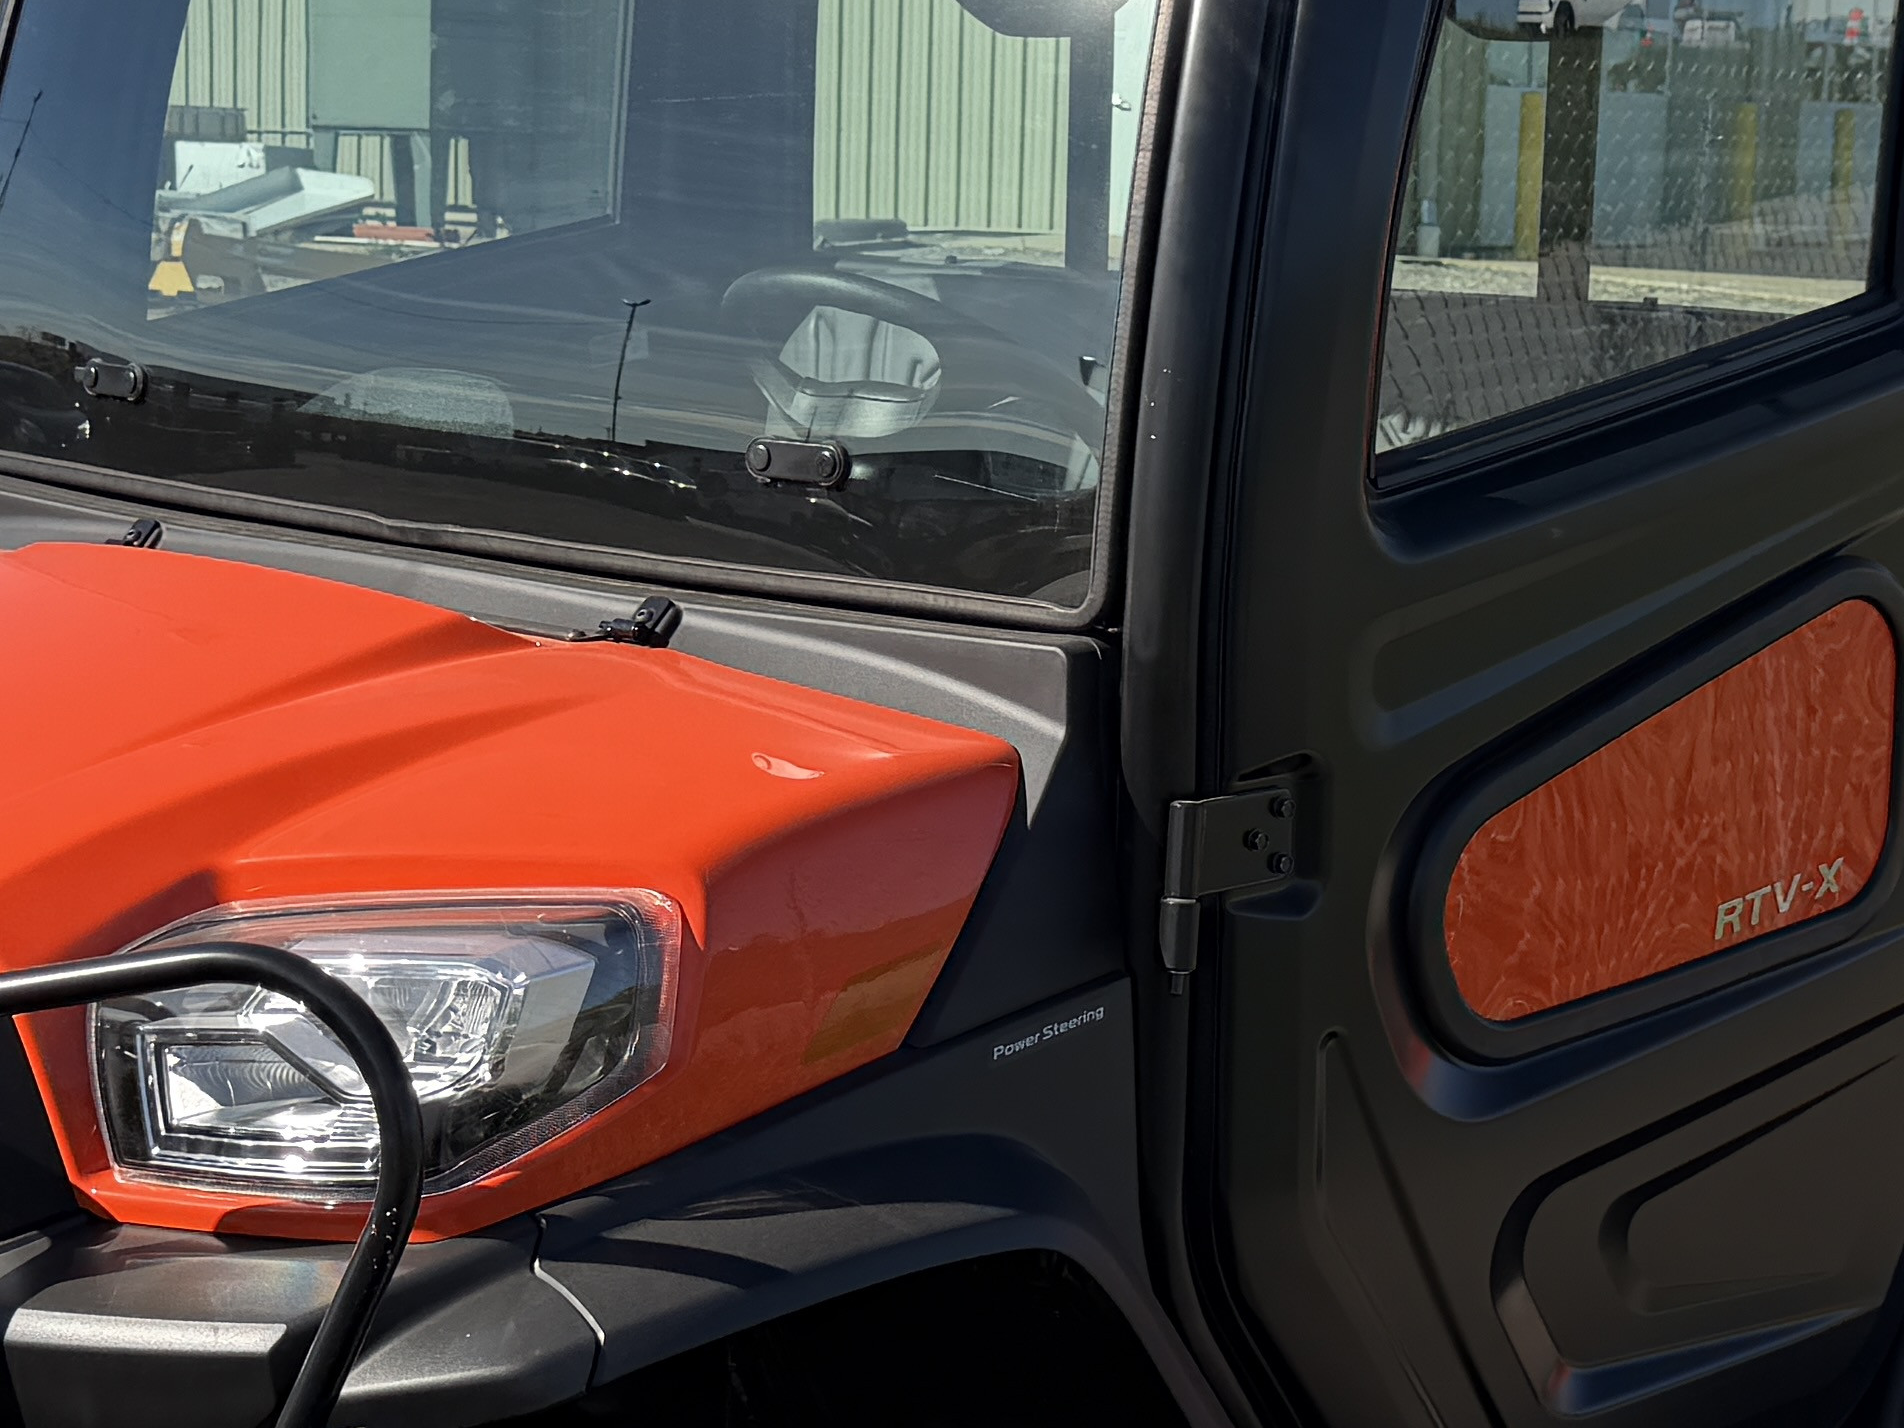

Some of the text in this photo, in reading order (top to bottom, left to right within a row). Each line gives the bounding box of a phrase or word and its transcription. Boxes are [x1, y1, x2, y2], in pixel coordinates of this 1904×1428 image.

[1714, 856, 1845, 941] RTV-X
[993, 1006, 1105, 1060] Power Steering
